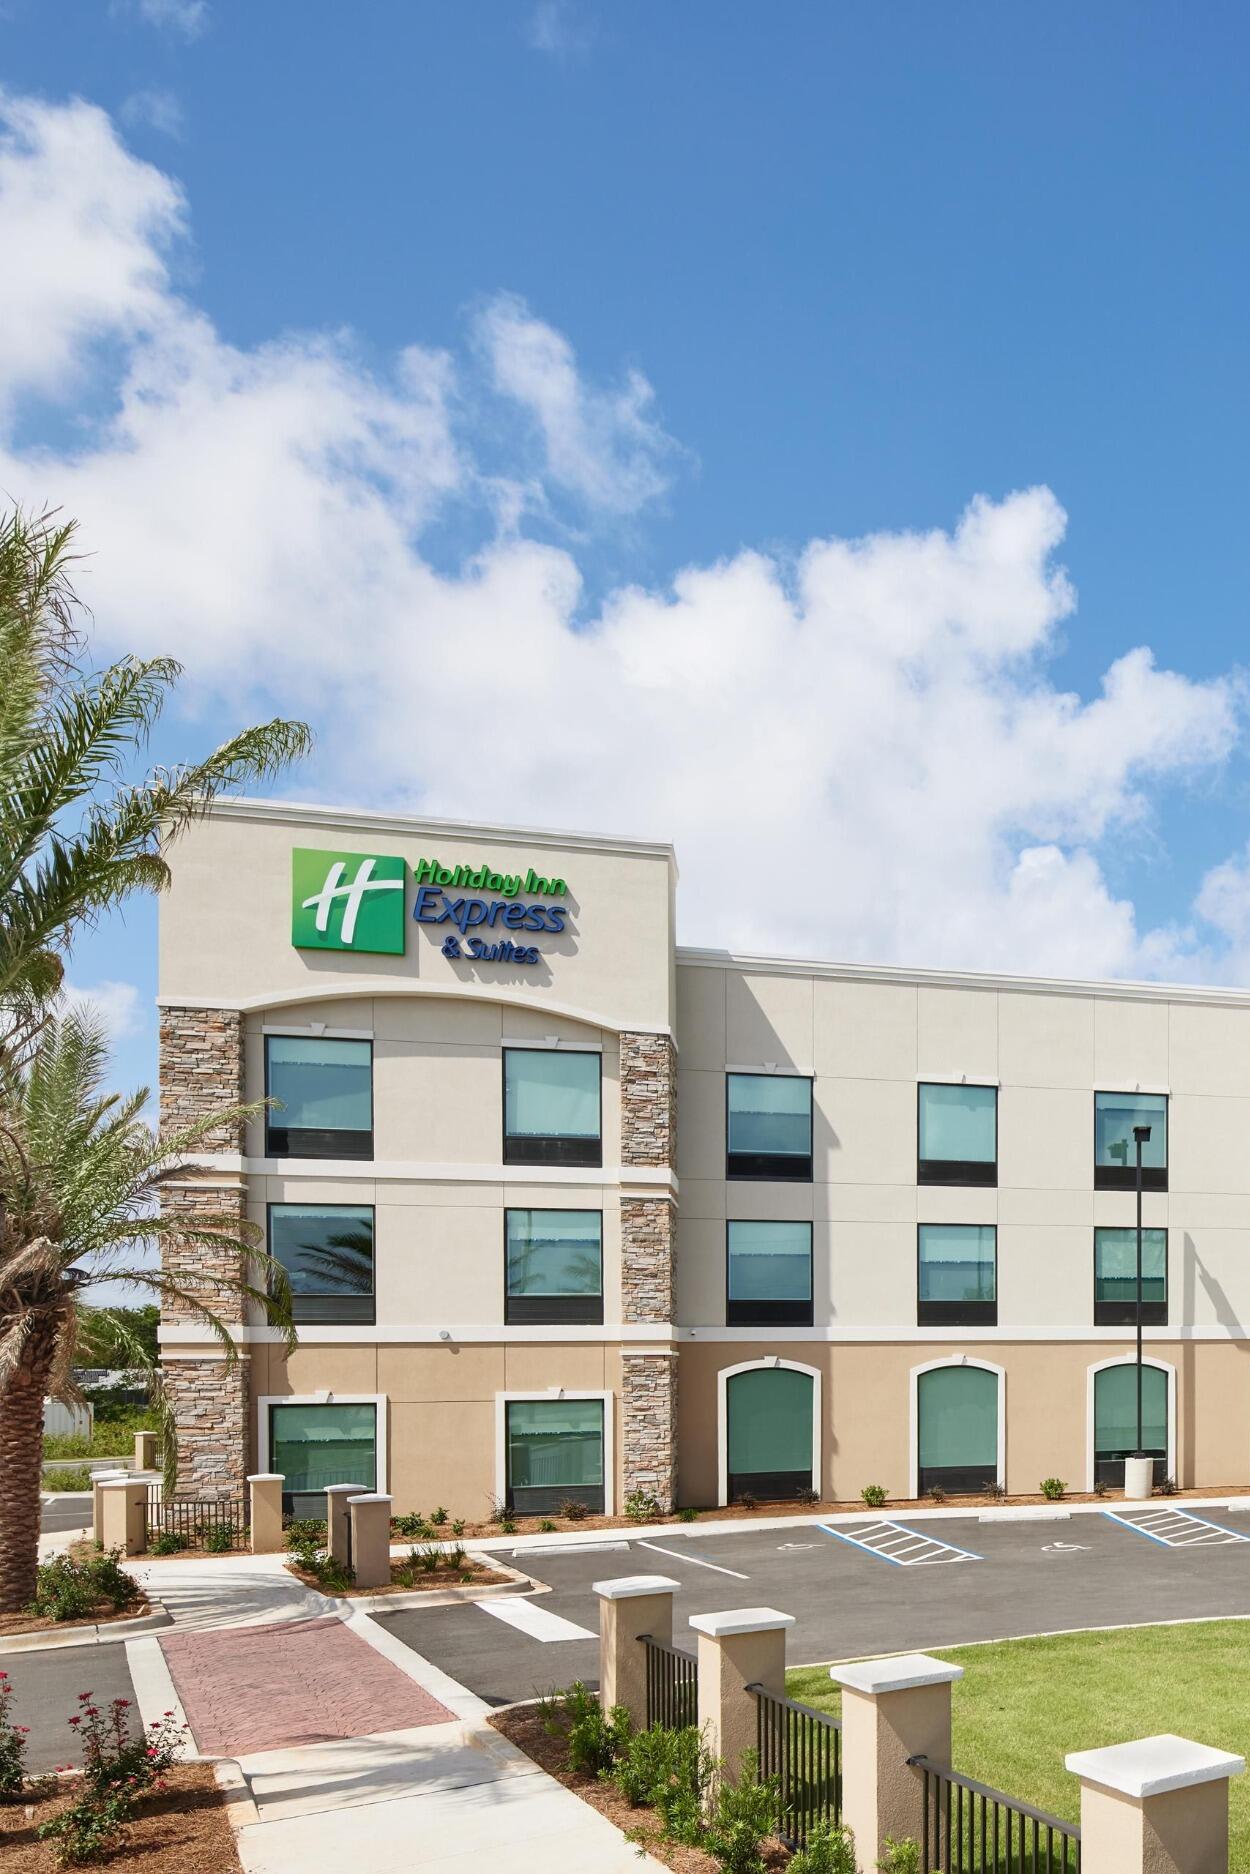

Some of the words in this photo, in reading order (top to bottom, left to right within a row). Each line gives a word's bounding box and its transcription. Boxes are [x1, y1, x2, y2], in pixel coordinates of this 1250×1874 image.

[414, 858, 521, 897] Holiday
[524, 868, 567, 896] Inn
[303, 858, 403, 944] H
[413, 886, 566, 935] Express
[441, 935, 461, 959] &
[464, 937, 539, 964] Suites
